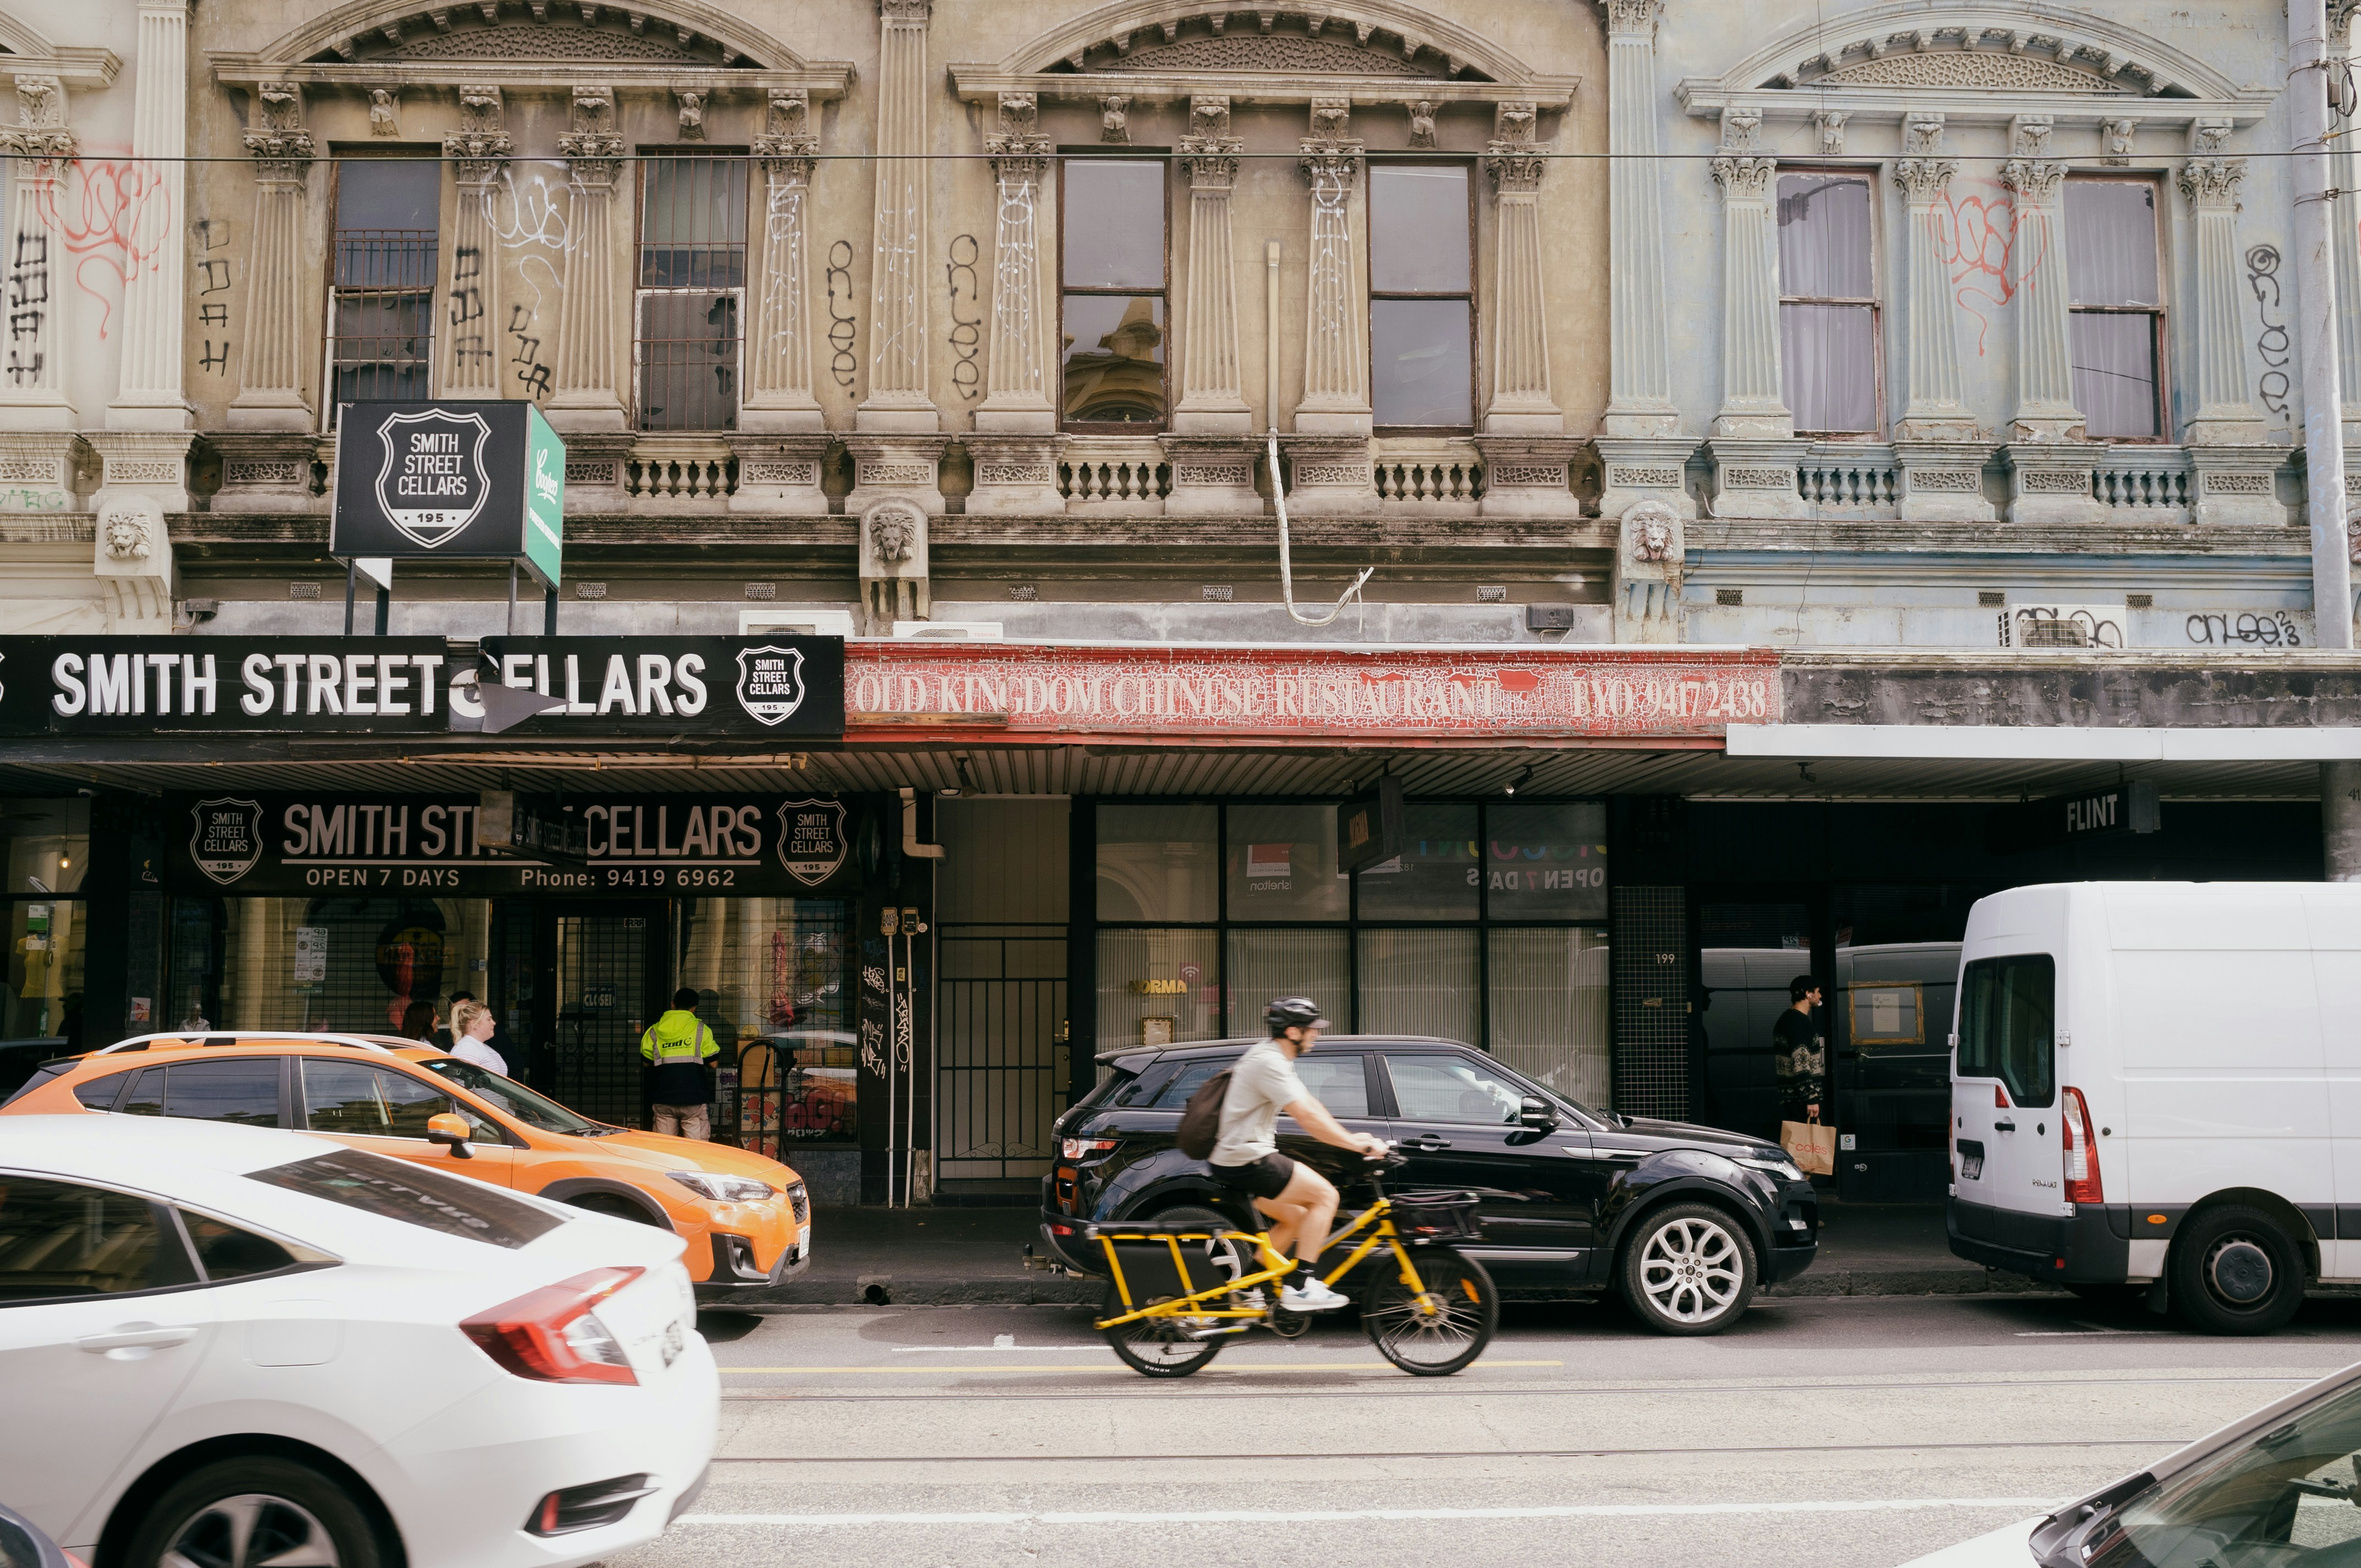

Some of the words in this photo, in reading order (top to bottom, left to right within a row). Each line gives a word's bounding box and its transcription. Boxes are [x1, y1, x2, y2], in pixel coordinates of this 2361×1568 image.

[410, 433, 459, 453] SMITH
[405, 454, 464, 475] STREET
[398, 475, 467, 496] CELLARS
[417, 513, 444, 522] 195
[755, 659, 784, 671] SMITH
[753, 671, 788, 683] STREET
[51, 653, 217, 716] SMITH
[240, 653, 444, 716] STREET
[449, 653, 708, 716] ELLARS
[749, 683, 790, 695] CELLARS
[855, 676, 927, 712] OLD
[939, 676, 1102, 715] KINGDOM
[1114, 677, 1263, 716] CHINESE
[1277, 678, 1499, 717] RESTAURANT
[1574, 680, 1633, 717] BYO
[212, 812, 243, 825] SMITH
[2067, 793, 2118, 832] FLINT
[797, 814, 827, 826] SMITH
[208, 826, 246, 839] STREET
[283, 804, 409, 856] SMITH
[585, 805, 762, 857] CELLARS
[526, 815, 542, 846] SMITH
[543, 821, 563, 851] STREET
[795, 827, 830, 840] STREET
[1349, 809, 1369, 850] NORMA
[204, 839, 248, 852] CELLARS
[791, 841, 833, 853] CELLARS
[306, 869, 367, 886] OPEN
[379, 869, 391, 886] 7
[403, 869, 461, 886] DAYS
[520, 869, 596, 886] Phone:
[607, 869, 666, 886] 9419
[677, 869, 736, 886] 6962
[1656, 953, 1675, 965] 199
[1129, 979, 1188, 994] NORMA
[1795, 1142, 1827, 1155] coles
[2032, 1179, 2058, 1189] RENAULT
